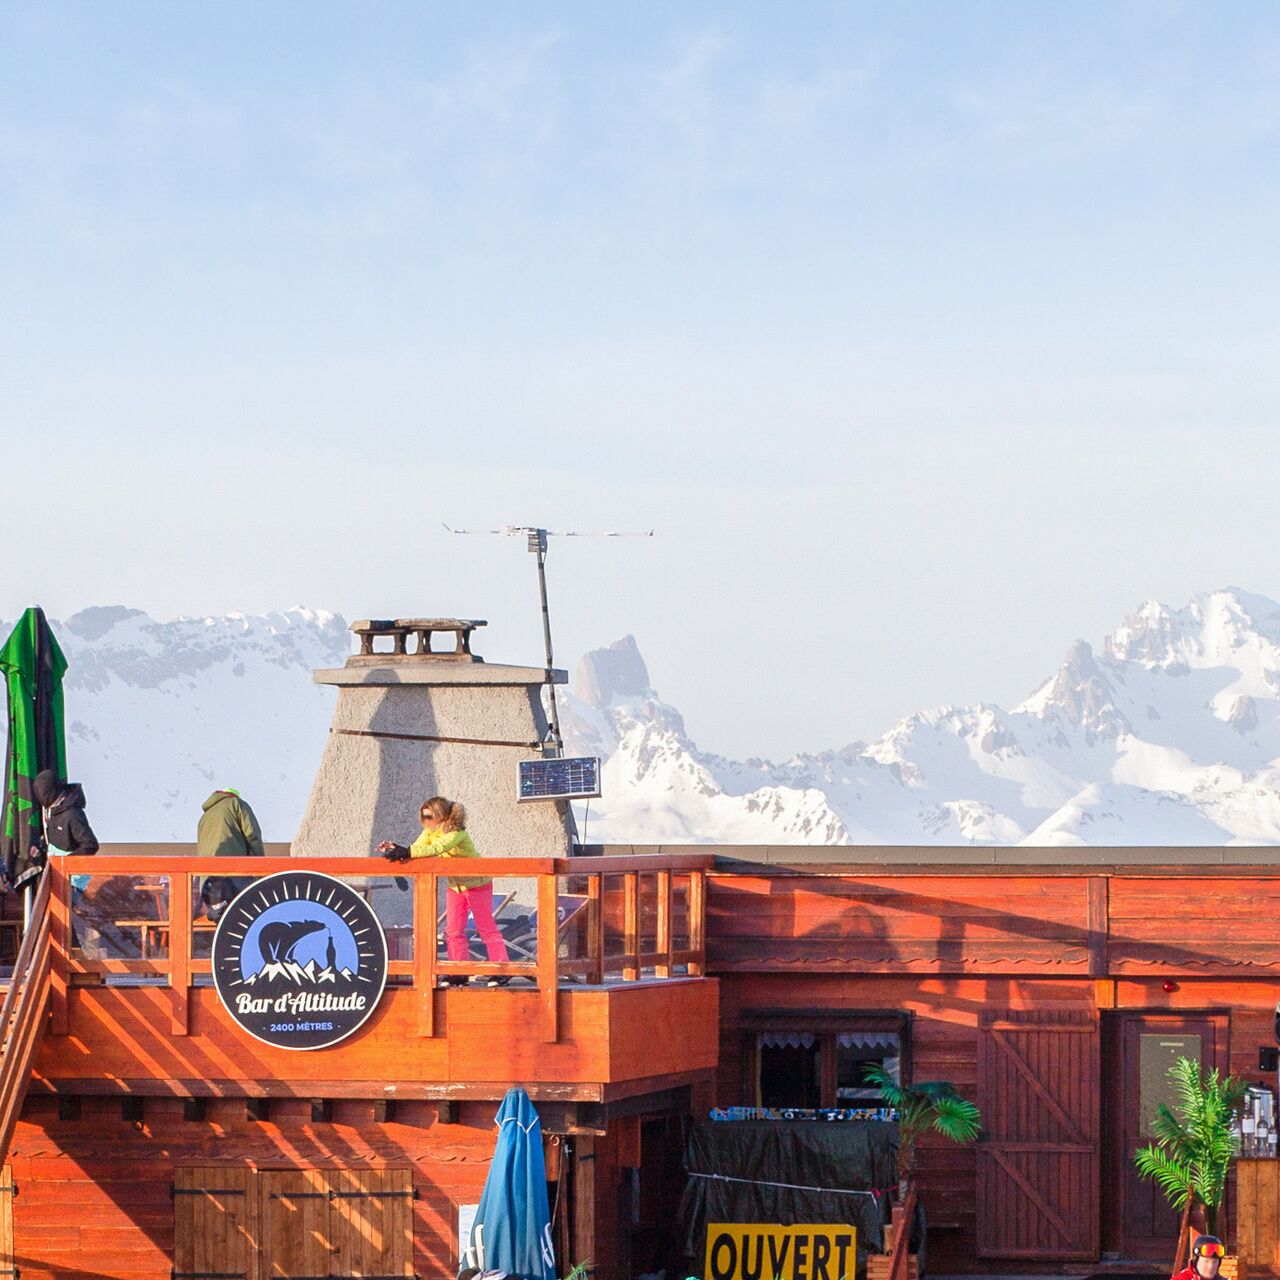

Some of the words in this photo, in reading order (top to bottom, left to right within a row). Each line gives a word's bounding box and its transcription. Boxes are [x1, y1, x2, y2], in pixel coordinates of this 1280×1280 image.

[235, 992, 273, 1014] Bar
[274, 991, 366, 1015] d'Altitude
[270, 1023, 294, 1032] 2400
[296, 1020, 333, 1031] MÈTRES
